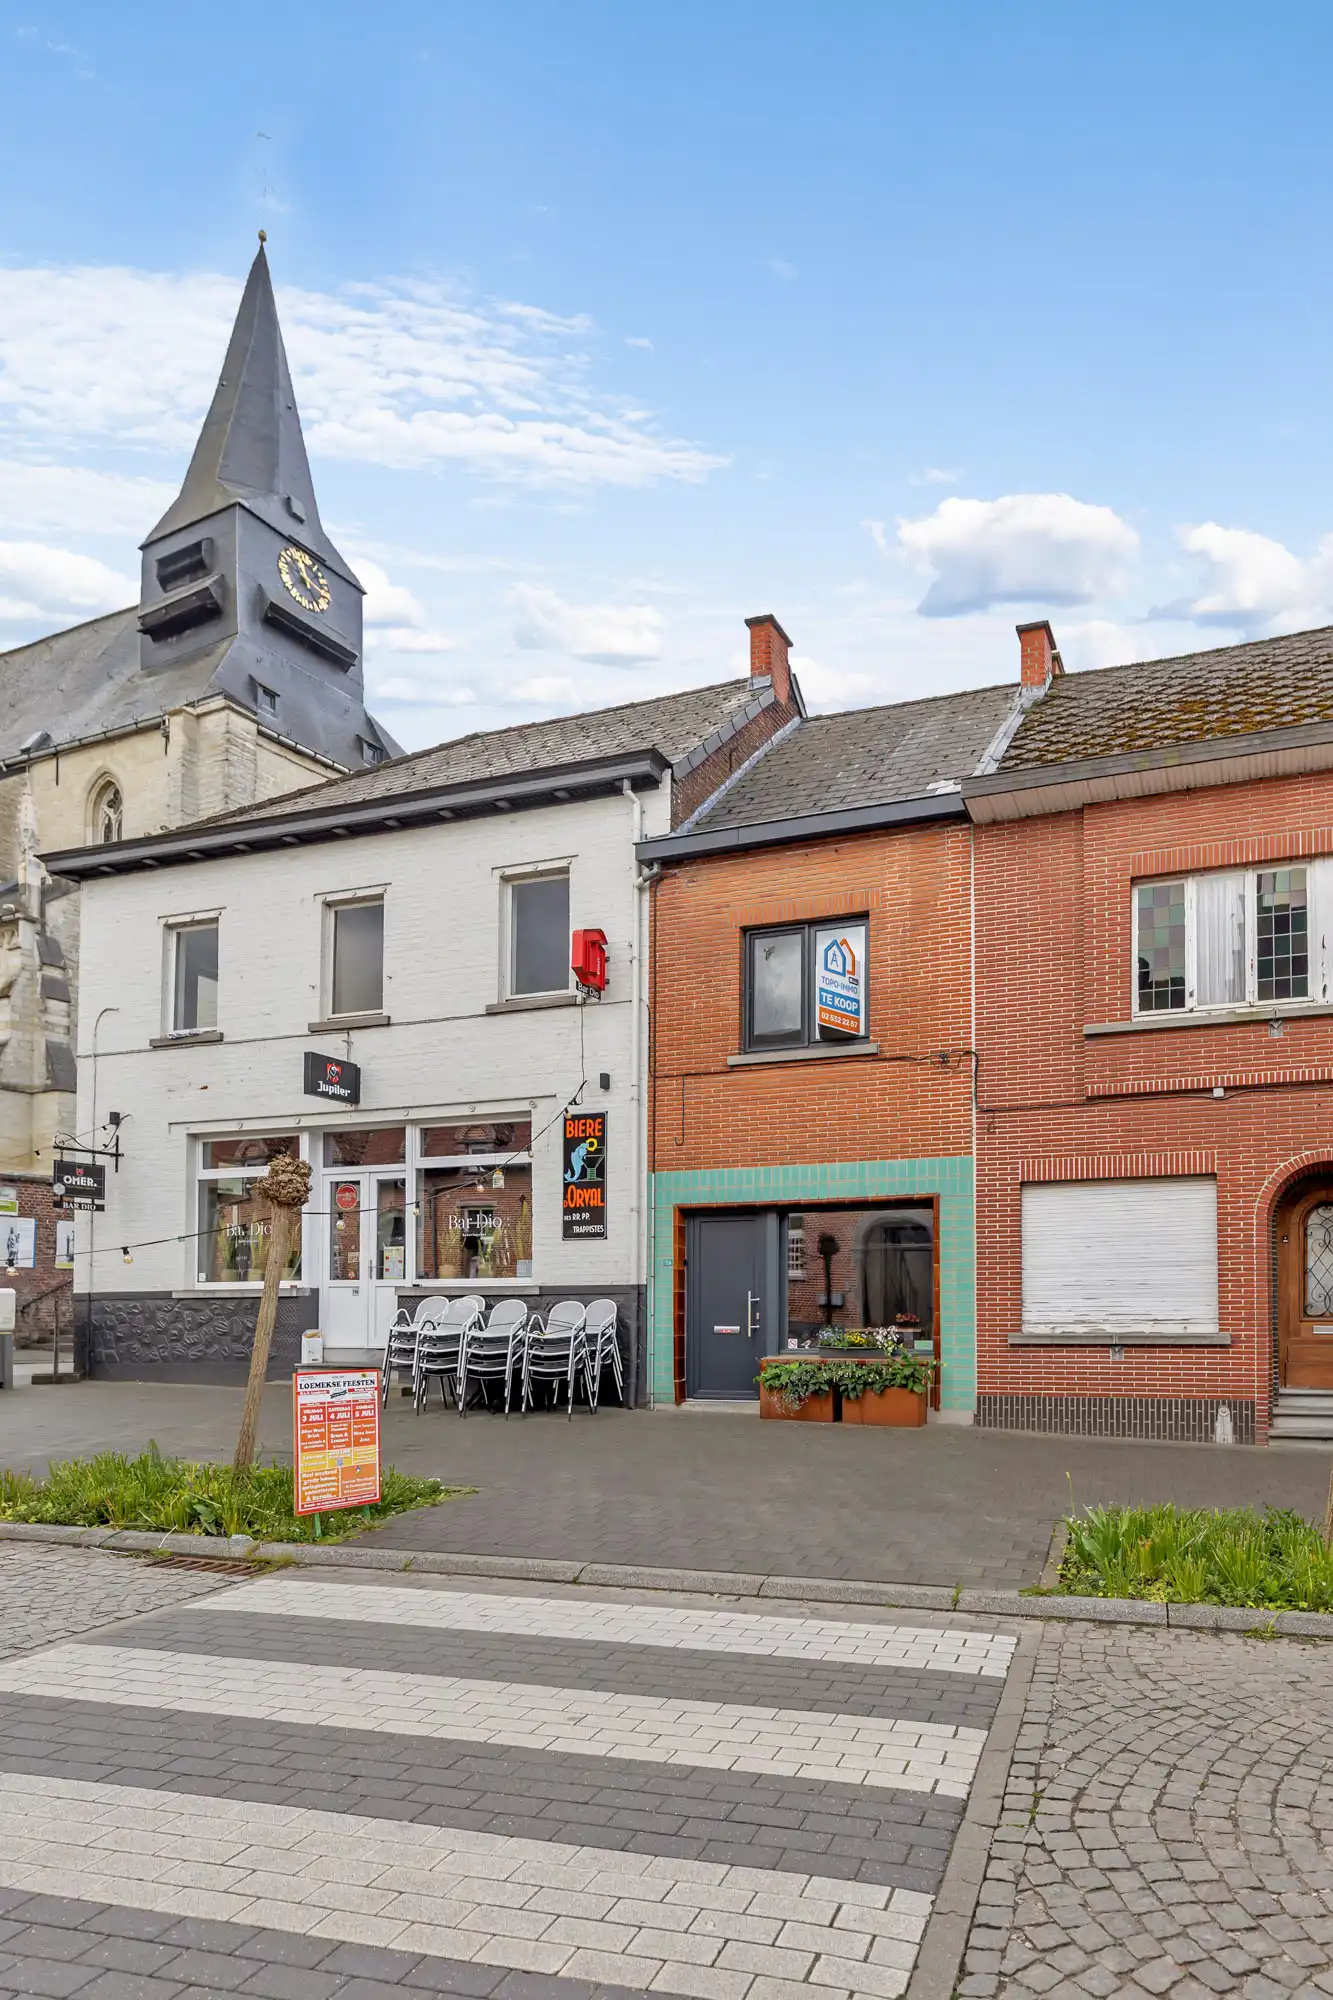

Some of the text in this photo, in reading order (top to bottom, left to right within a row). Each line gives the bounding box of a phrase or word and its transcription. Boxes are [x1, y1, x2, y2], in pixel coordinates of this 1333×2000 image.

[821, 976, 857, 994] TOPO-IMMO
[821, 992, 858, 1012] TE KOOP
[821, 1012, 829, 1020] 02
[317, 1080, 351, 1097] Jupiler
[566, 1118, 603, 1138] BIERE
[63, 1202, 96, 1211] BAR DIO
[448, 1213, 502, 1229] Bar Dio
[573, 1225, 604, 1233] TRAPPISTES
[299, 1379, 375, 1390] LOEMEKSE FEESTEN
[308, 1414, 323, 1422] JULI
